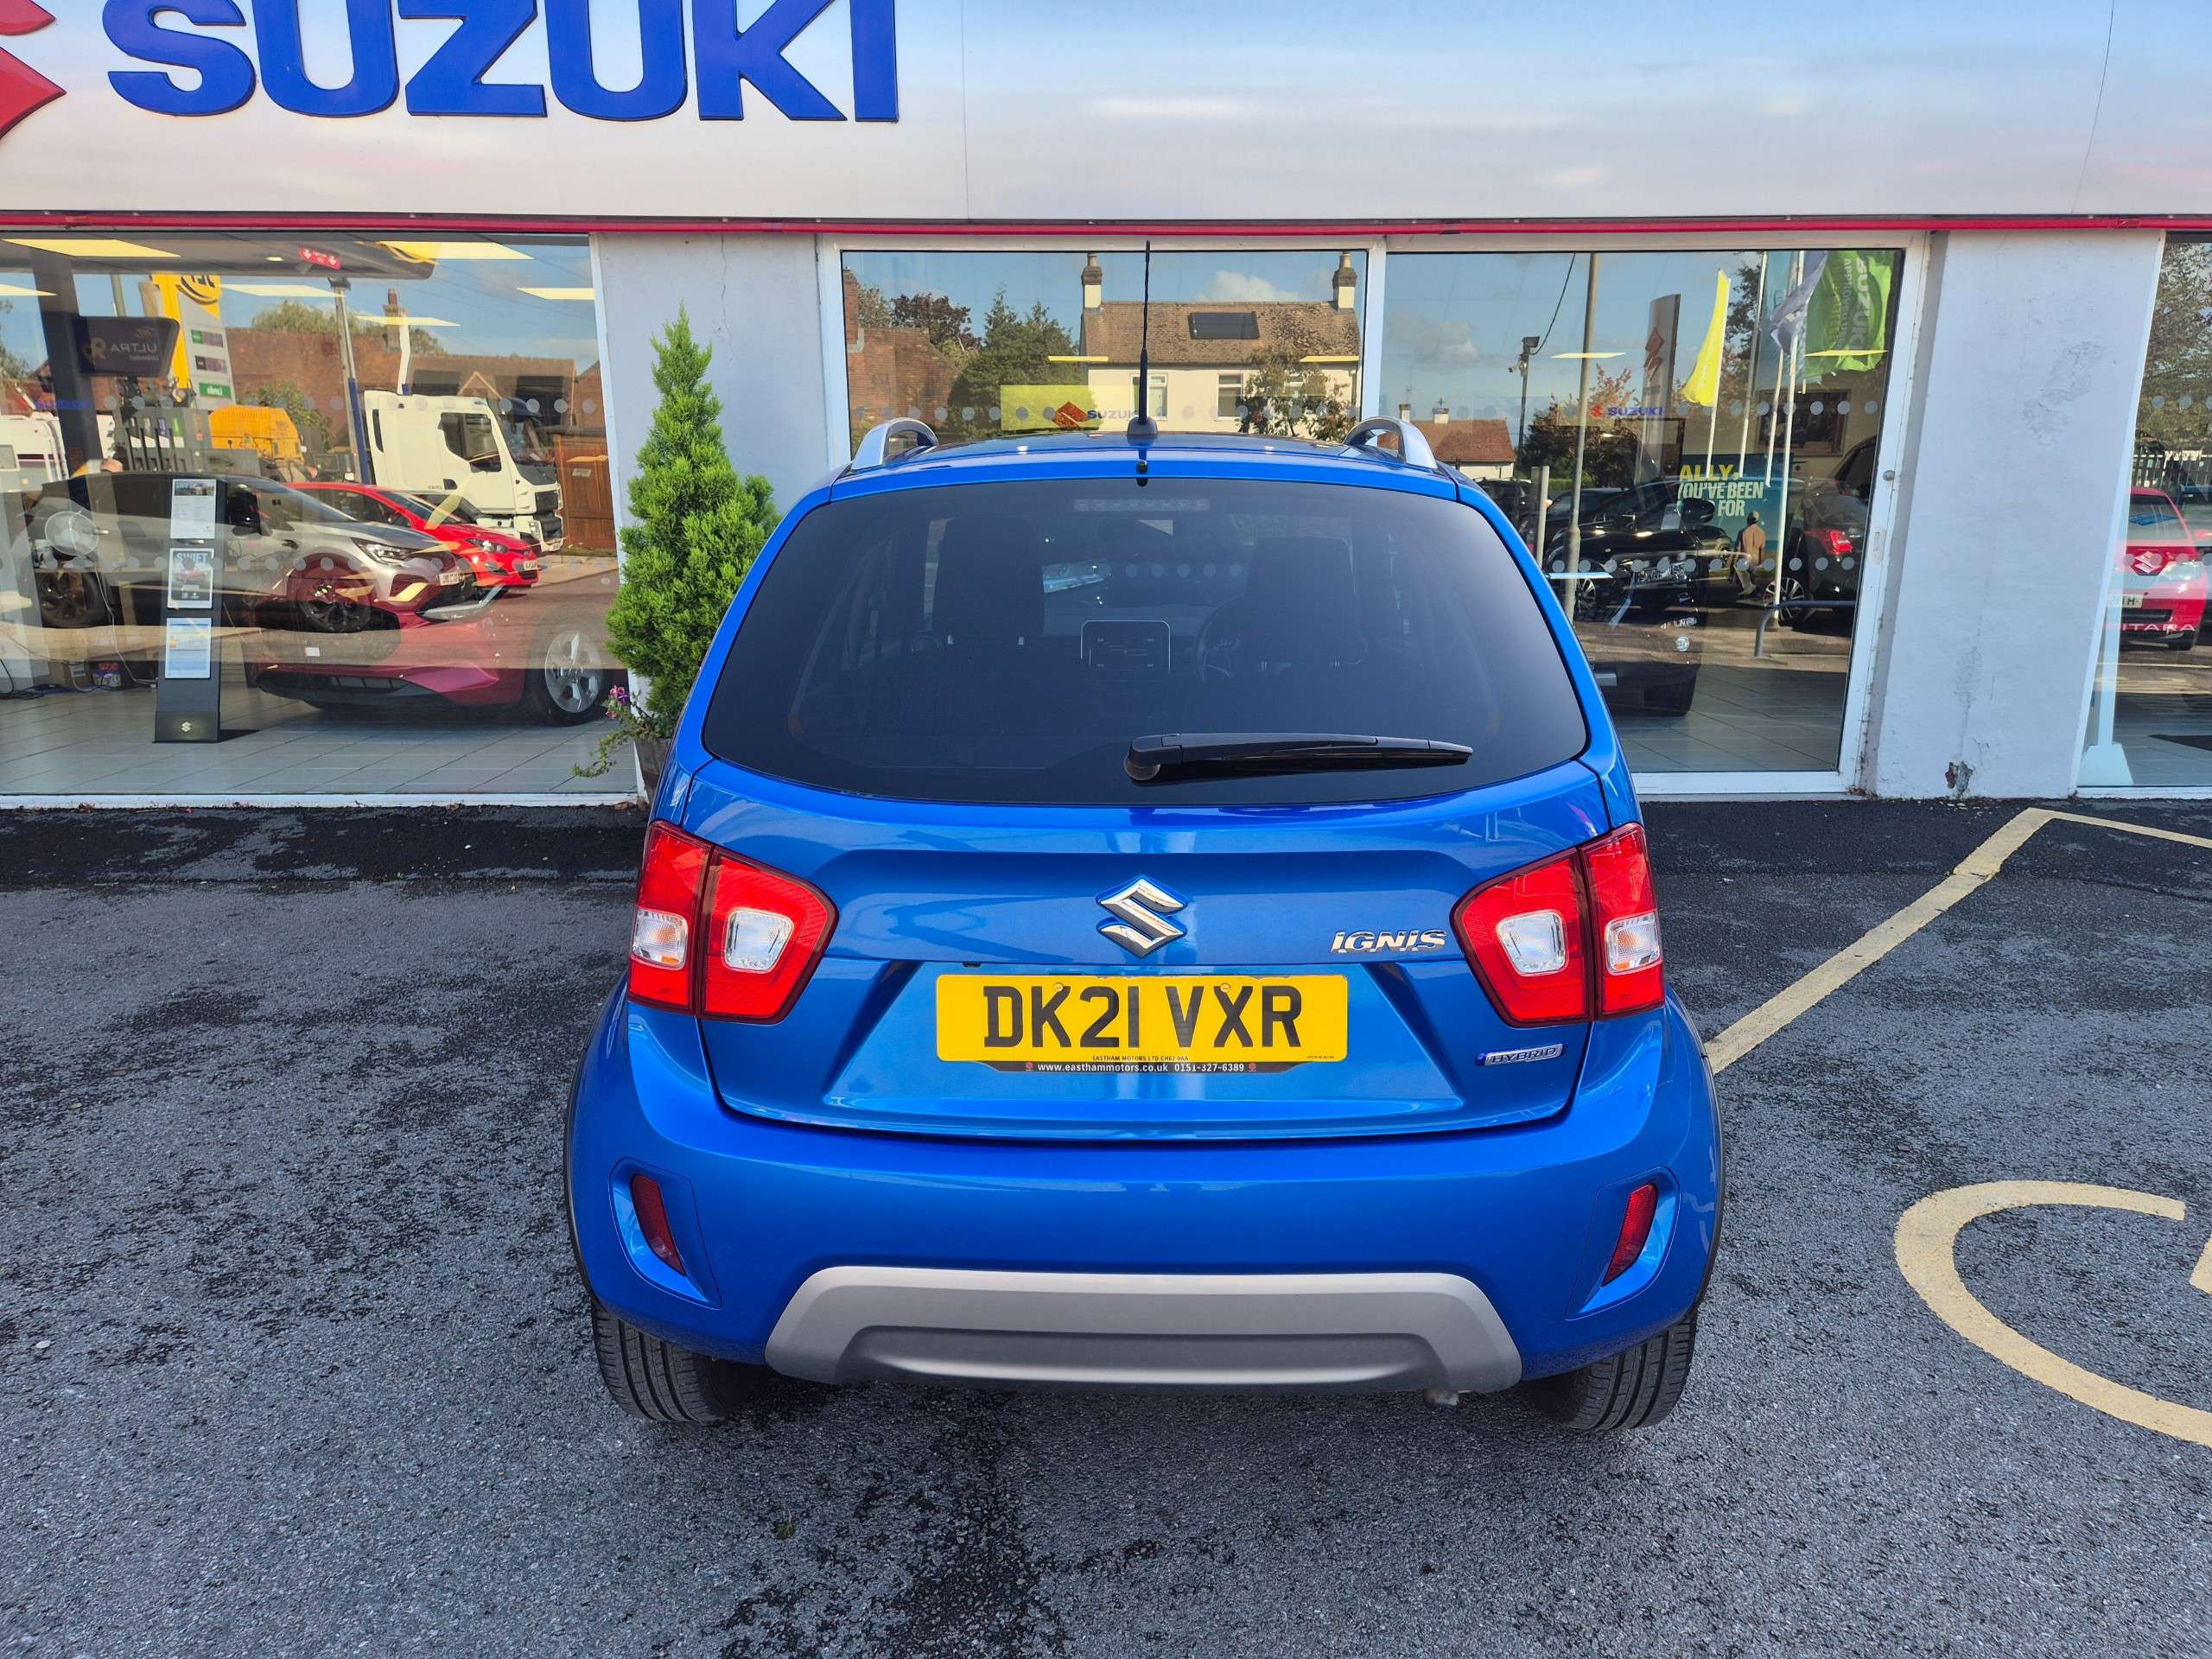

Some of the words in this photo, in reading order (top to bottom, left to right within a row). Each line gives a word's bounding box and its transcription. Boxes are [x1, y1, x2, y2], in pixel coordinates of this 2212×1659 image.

[102, 0, 899, 121] SUZUKI
[1852, 257, 1871, 345] SUZUK
[1087, 410, 1139, 419] SUZUK
[1607, 406, 1664, 416] SUZUKI
[1726, 481, 1764, 499] BEEN
[1717, 499, 1746, 518] FOR
[2122, 623, 2196, 632] ITARA
[983, 985, 1141, 1048] DK21
[1166, 985, 1302, 1048] VXR
[1491, 1046, 1559, 1065] HYBRID
[1037, 1062, 1169, 1072] www.easthammotors.co.uk
[1174, 1062, 1245, 1072] 0151-327-6389
